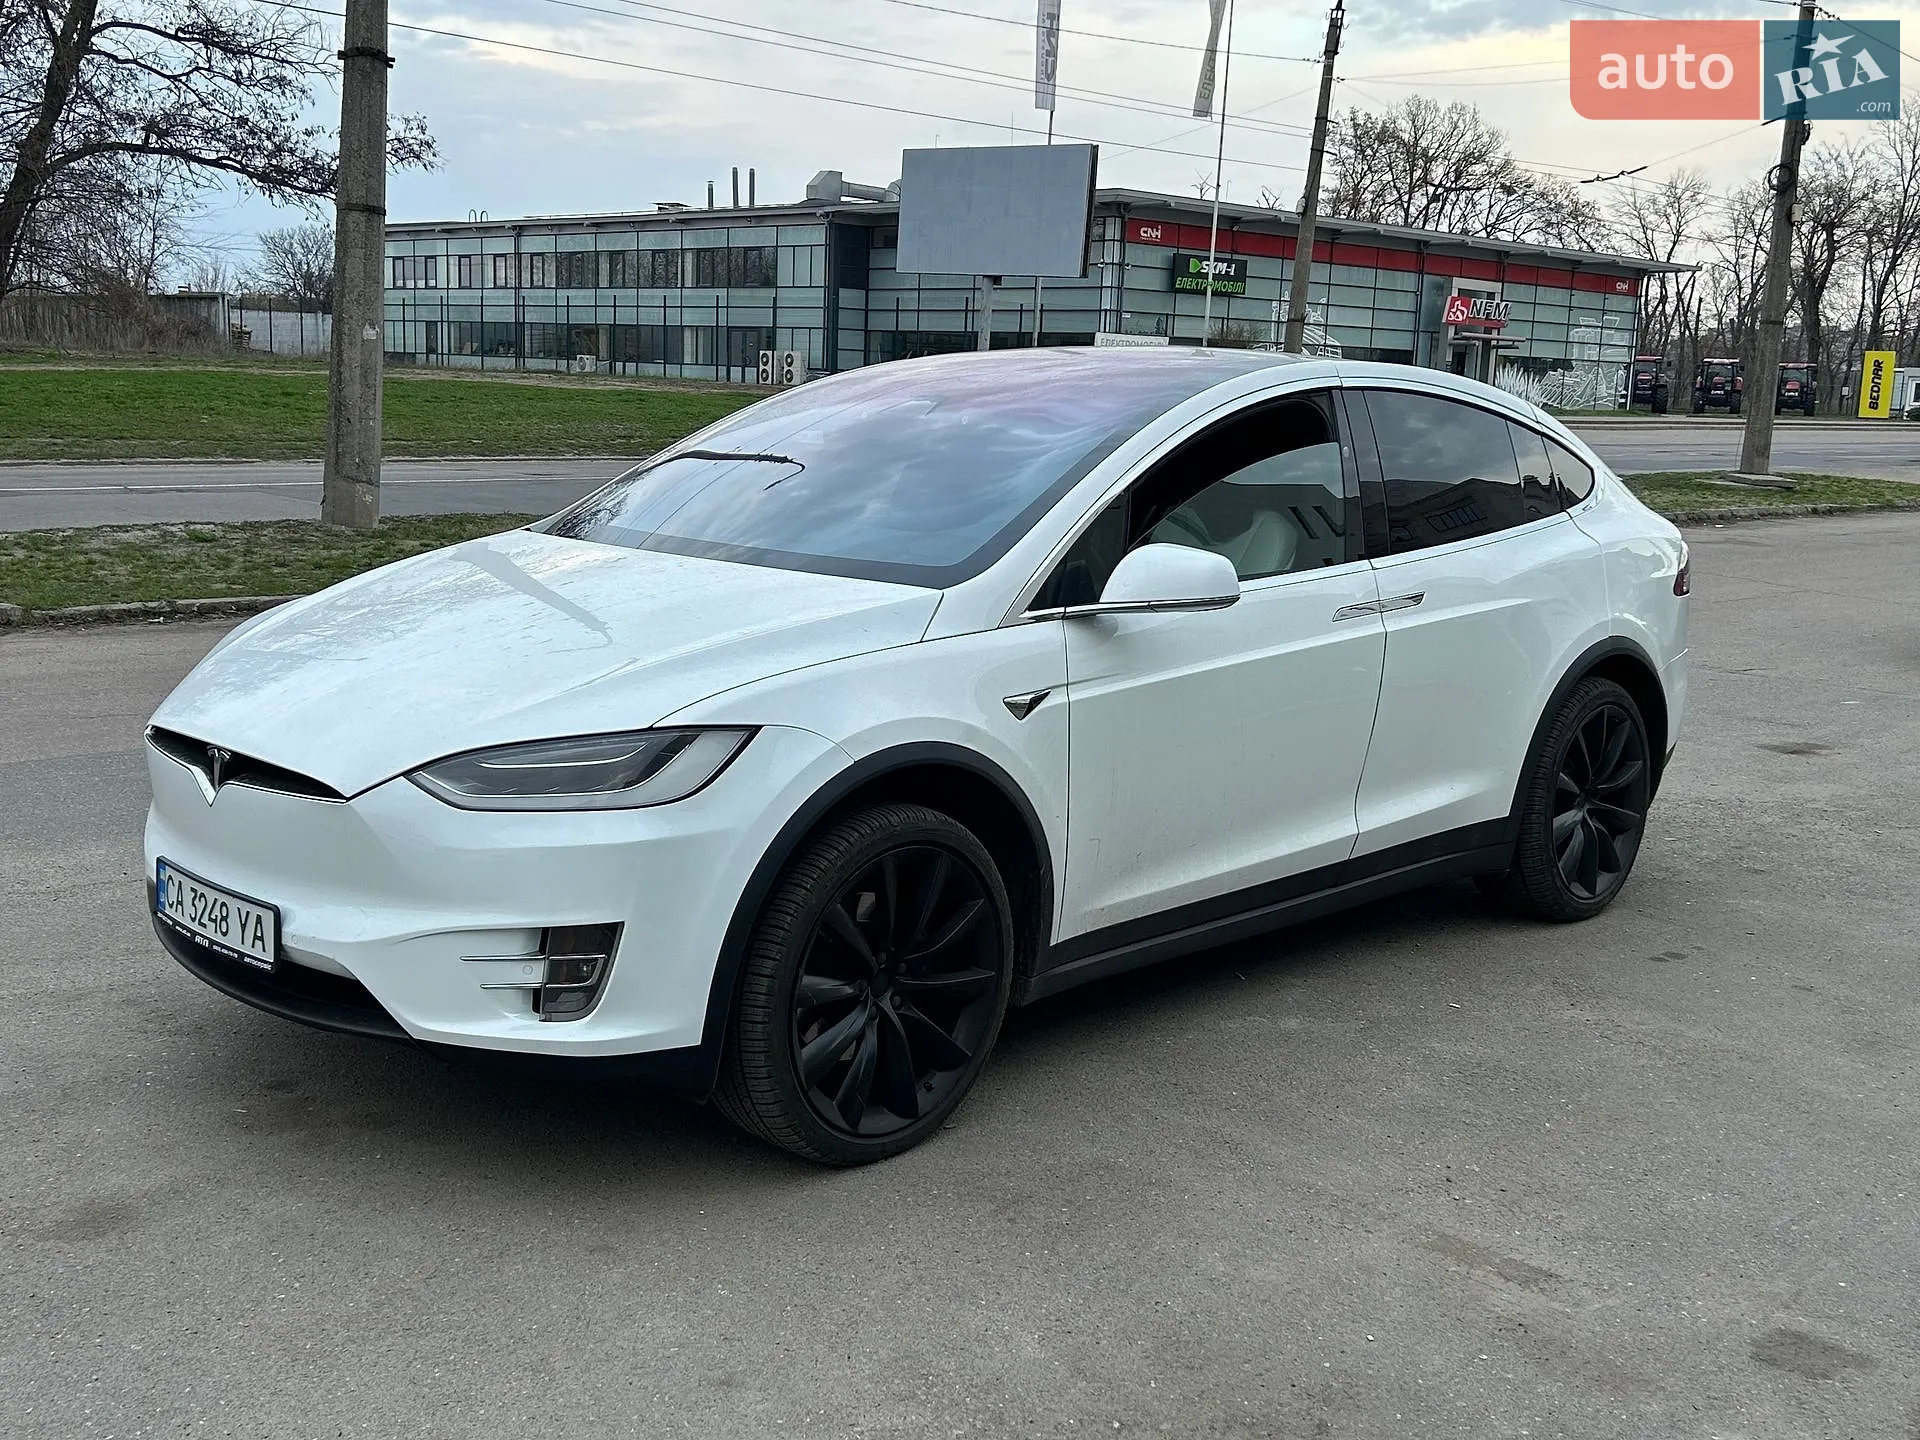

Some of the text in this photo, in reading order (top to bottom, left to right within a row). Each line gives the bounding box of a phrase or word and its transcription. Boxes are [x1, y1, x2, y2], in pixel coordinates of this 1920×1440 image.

[1140, 225, 1161, 239] CNH
[1175, 277, 1245, 293] ЕЛЕКТРОМОБІЛІ
[1469, 299, 1511, 320] NFM
[1868, 359, 1884, 410] BEDNAR
[166, 874, 266, 952] CA 3248 YA
